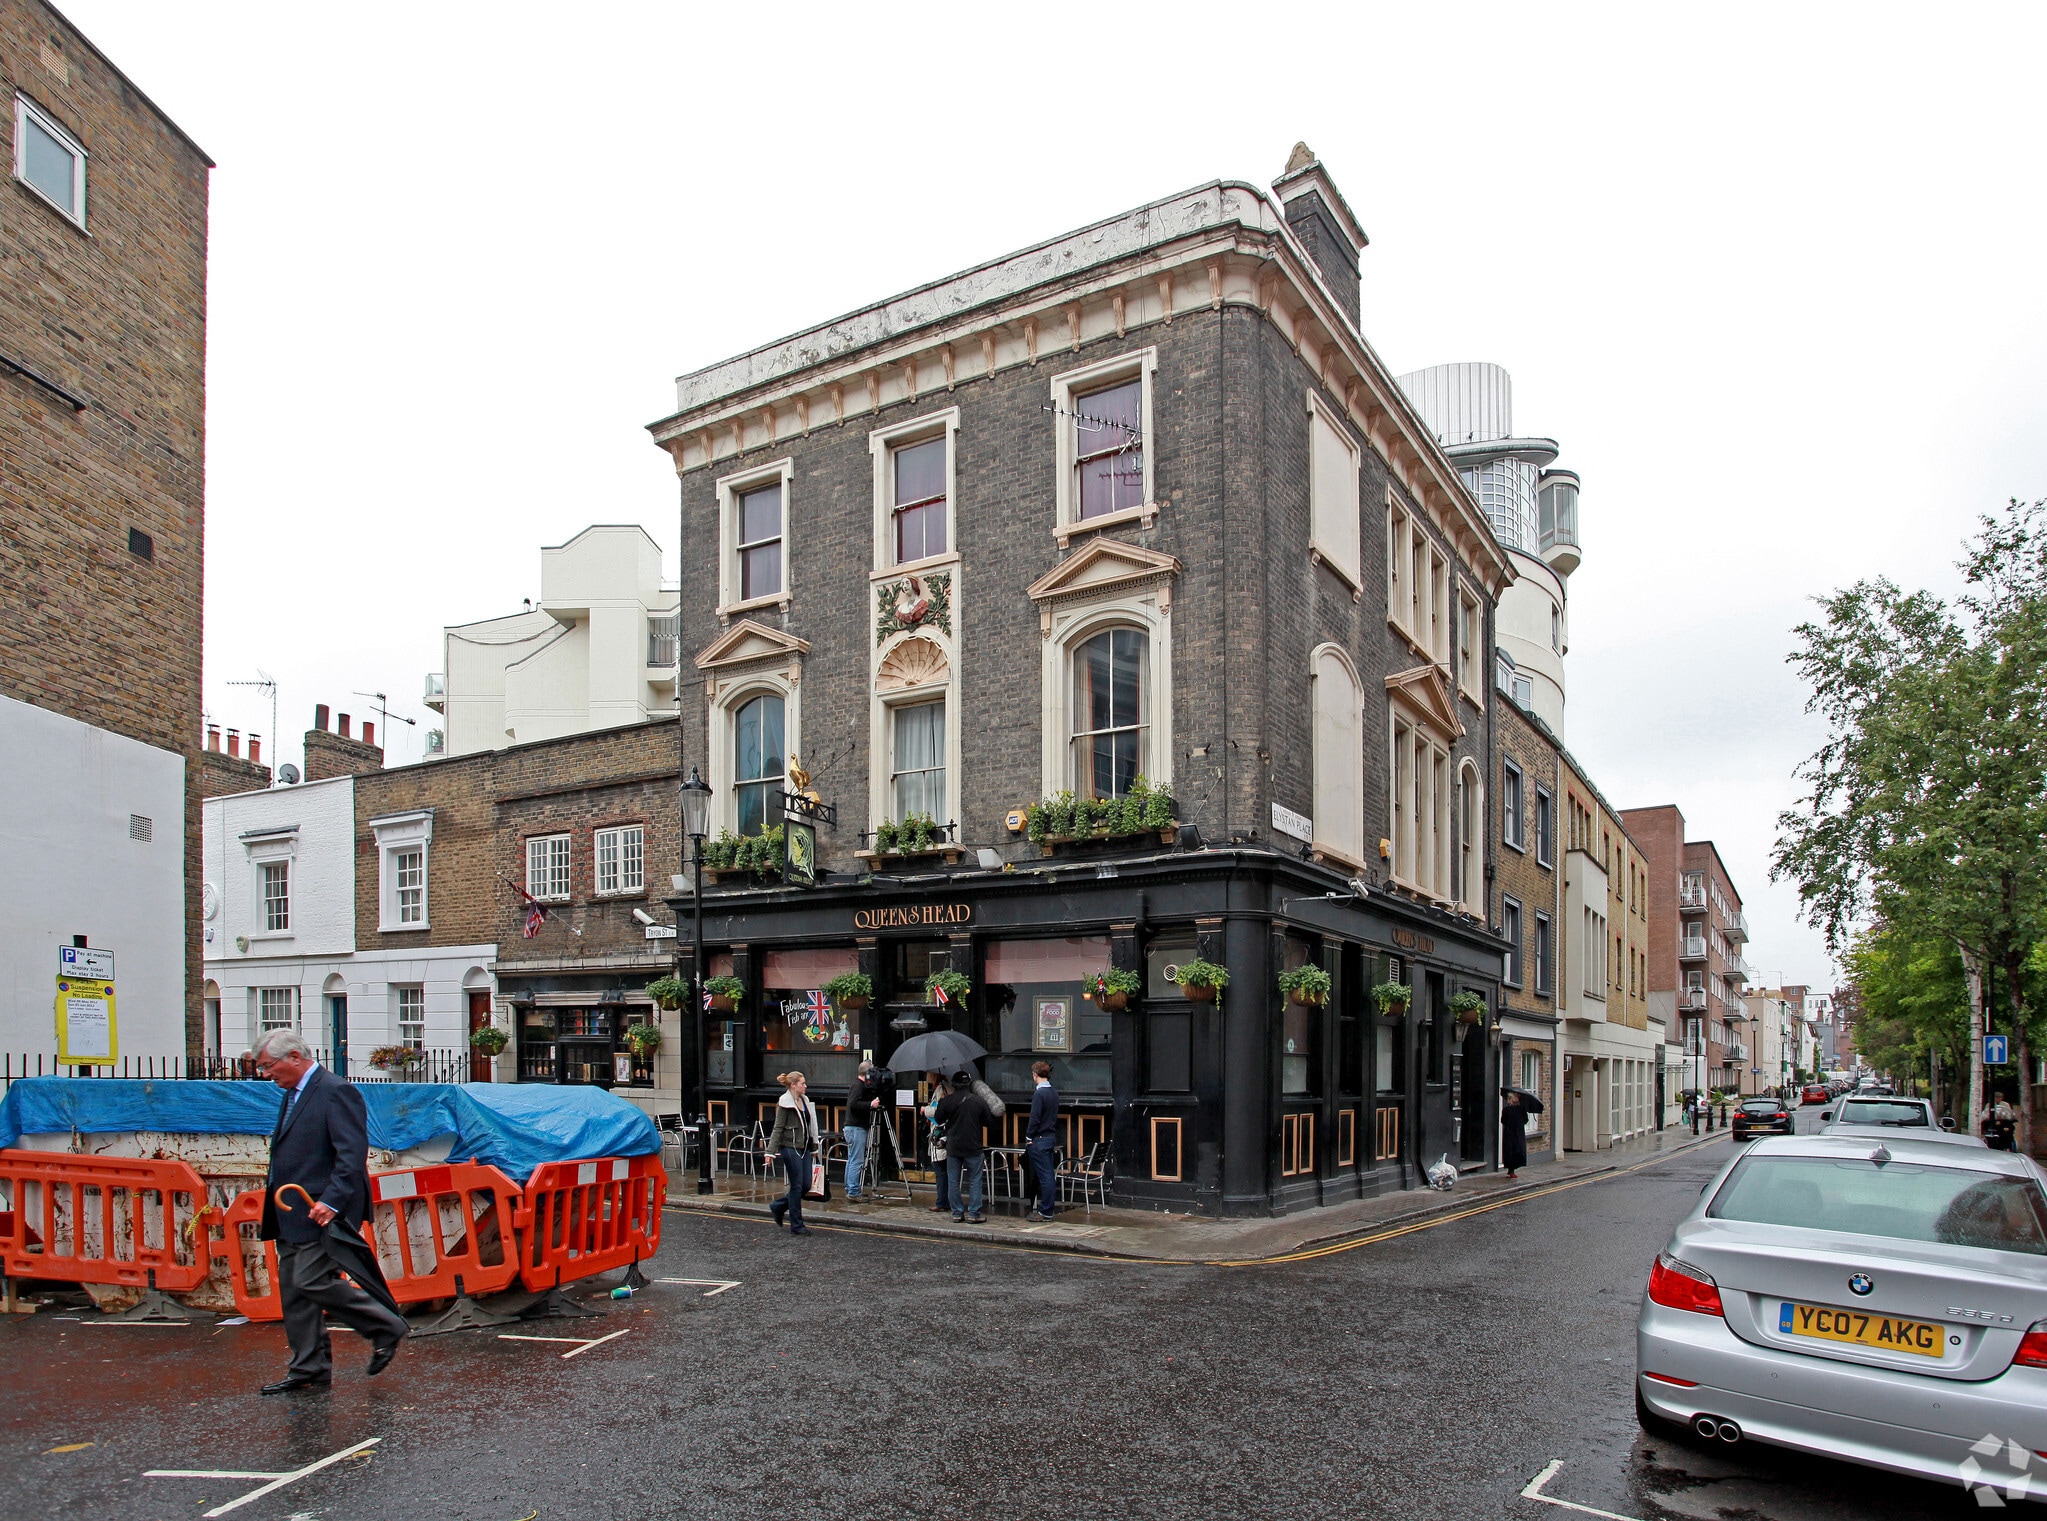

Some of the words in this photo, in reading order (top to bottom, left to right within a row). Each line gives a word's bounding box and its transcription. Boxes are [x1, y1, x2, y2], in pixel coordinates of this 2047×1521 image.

[1273, 809, 1296, 828] ELYSTAN
[1296, 821, 1311, 836] PLACE
[854, 905, 920, 929] QUEENS
[922, 904, 971, 924] HEAD
[648, 928, 661, 937] TRYON
[65, 950, 74, 961] P
[70, 984, 103, 992] Suspension
[787, 1011, 800, 1027] Fish
[1800, 1307, 1869, 1338] YC07
[1878, 1319, 1934, 1349] AKG
